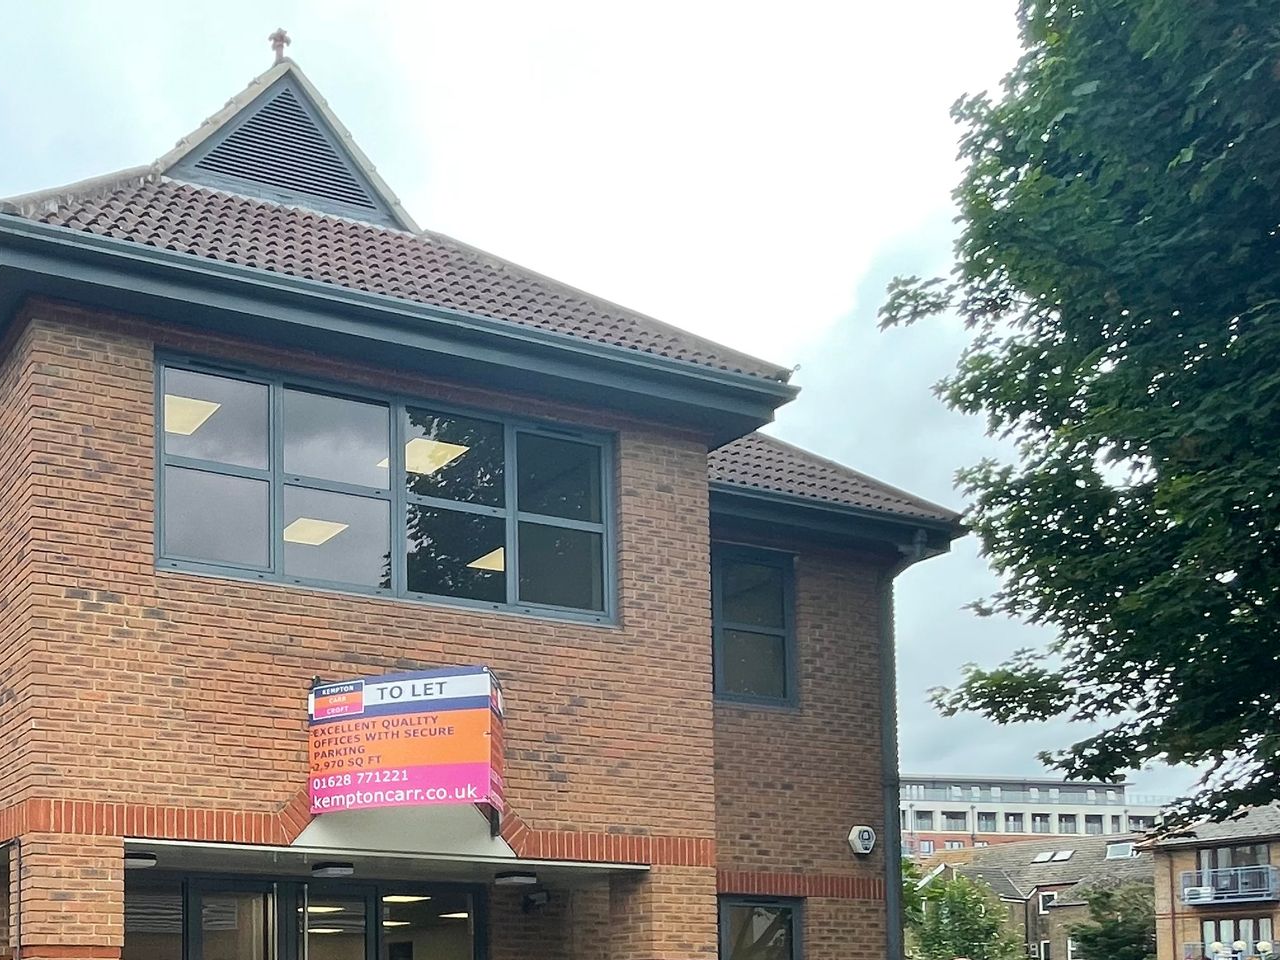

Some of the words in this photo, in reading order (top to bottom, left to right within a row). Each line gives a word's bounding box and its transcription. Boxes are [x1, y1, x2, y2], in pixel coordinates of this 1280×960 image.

[322, 685, 354, 695] KEMPTON
[377, 686, 403, 700] TO
[411, 681, 448, 697] LET
[326, 705, 349, 715] CROFT
[313, 721, 377, 738] EXCELLENT
[381, 715, 439, 729] QUALITY
[313, 734, 361, 749] OFFICES
[365, 730, 400, 741] WITH
[404, 726, 455, 739] SECURE
[313, 745, 366, 760] PARKING
[347, 757, 364, 767] SQ
[367, 755, 382, 765] FT
[313, 774, 352, 791] 01628
[357, 769, 409, 785] 771221
[313, 783, 478, 809] kemptoncarr.co.uk
